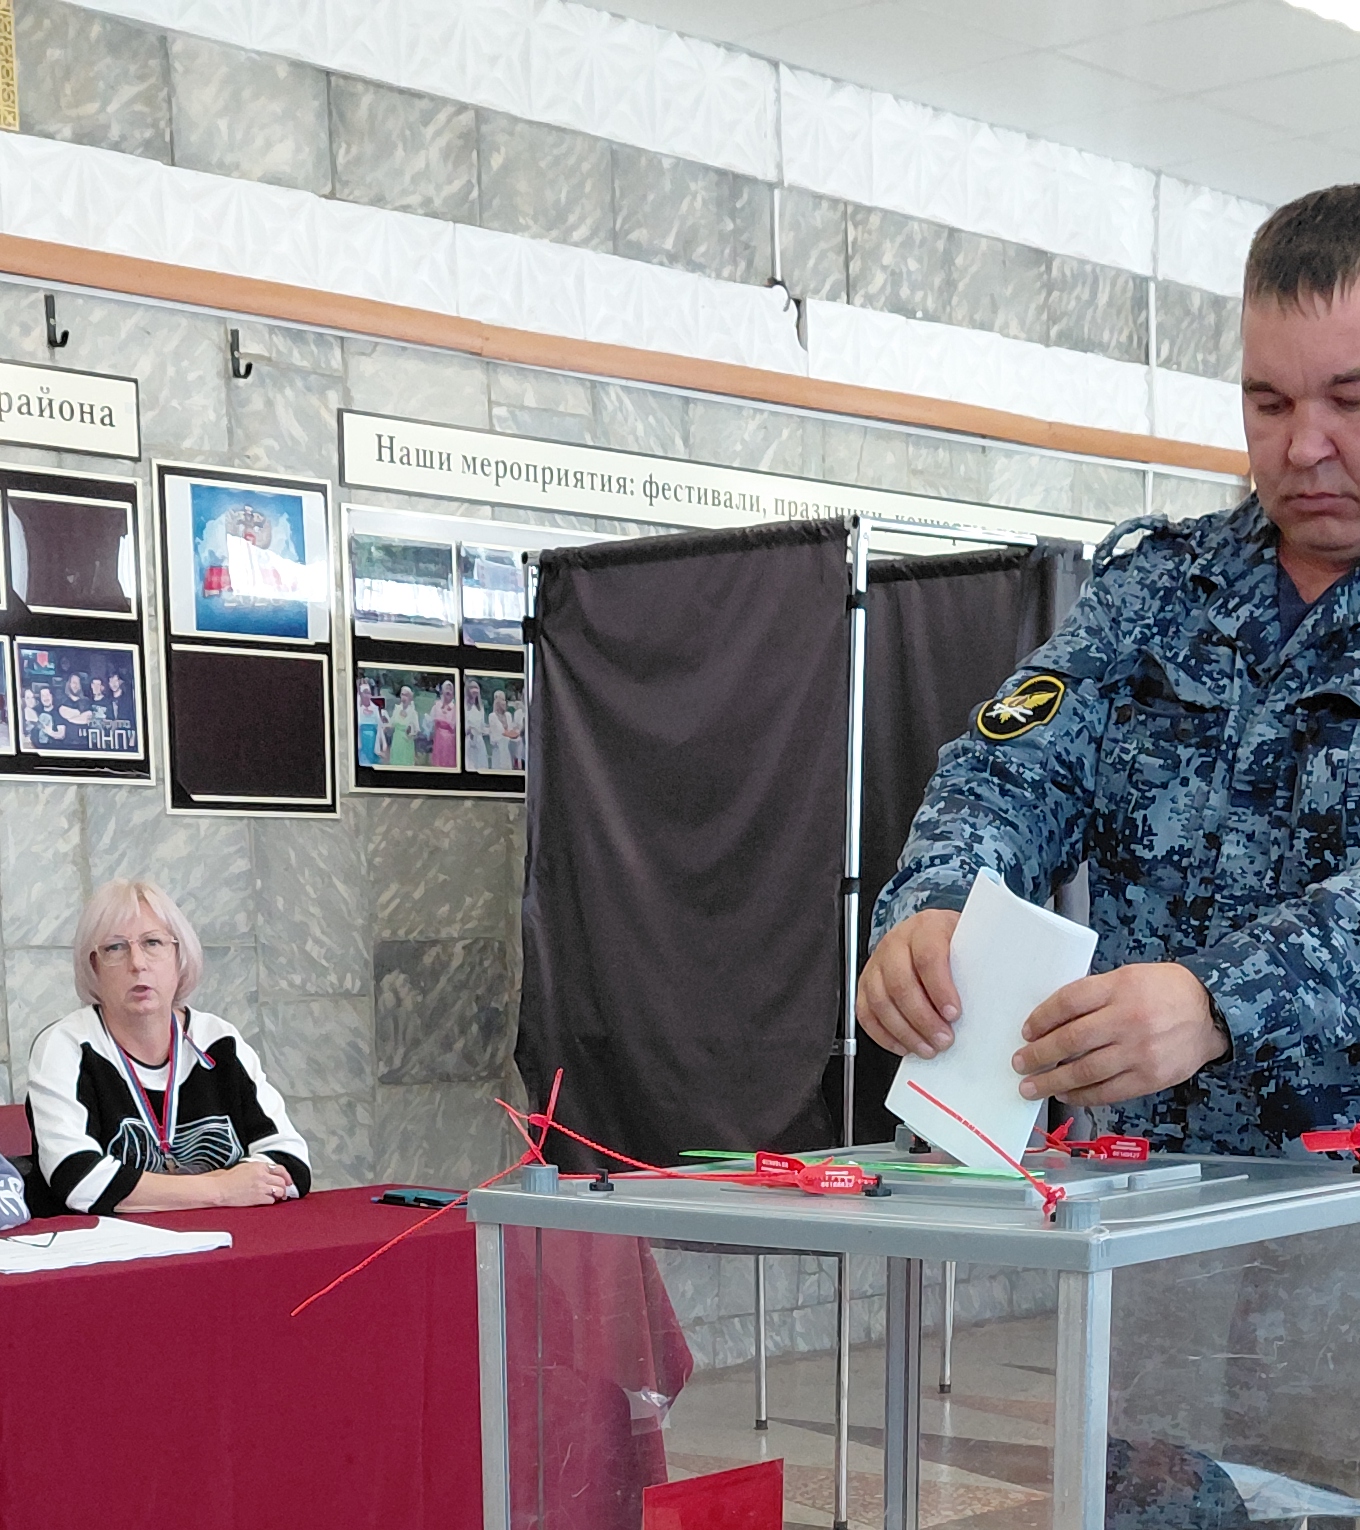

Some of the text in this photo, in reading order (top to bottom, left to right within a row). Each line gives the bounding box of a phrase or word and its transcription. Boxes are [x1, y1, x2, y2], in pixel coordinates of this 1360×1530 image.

[375, 433, 453, 473] Наши
[461, 454, 635, 497] мероприятия:
[642, 473, 768, 516] фестивали,
[79, 727, 136, 750] "ПНП"
